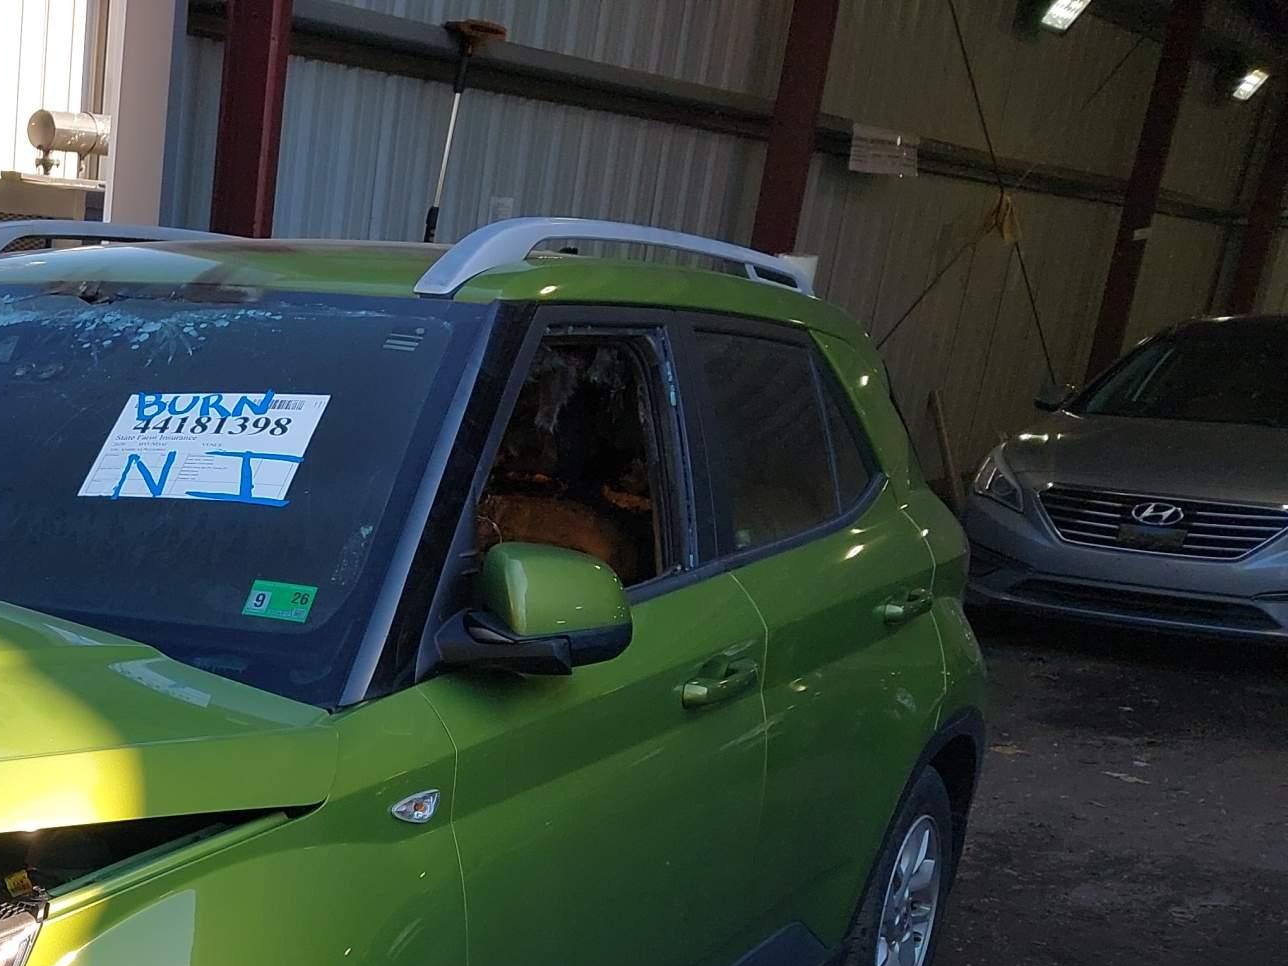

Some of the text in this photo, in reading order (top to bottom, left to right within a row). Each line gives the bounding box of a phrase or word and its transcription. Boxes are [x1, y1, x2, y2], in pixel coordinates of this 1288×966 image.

[136, 389, 275, 421] BURN
[133, 415, 292, 436] 44181398
[253, 592, 266, 608] 9
[291, 592, 310, 605] 26
